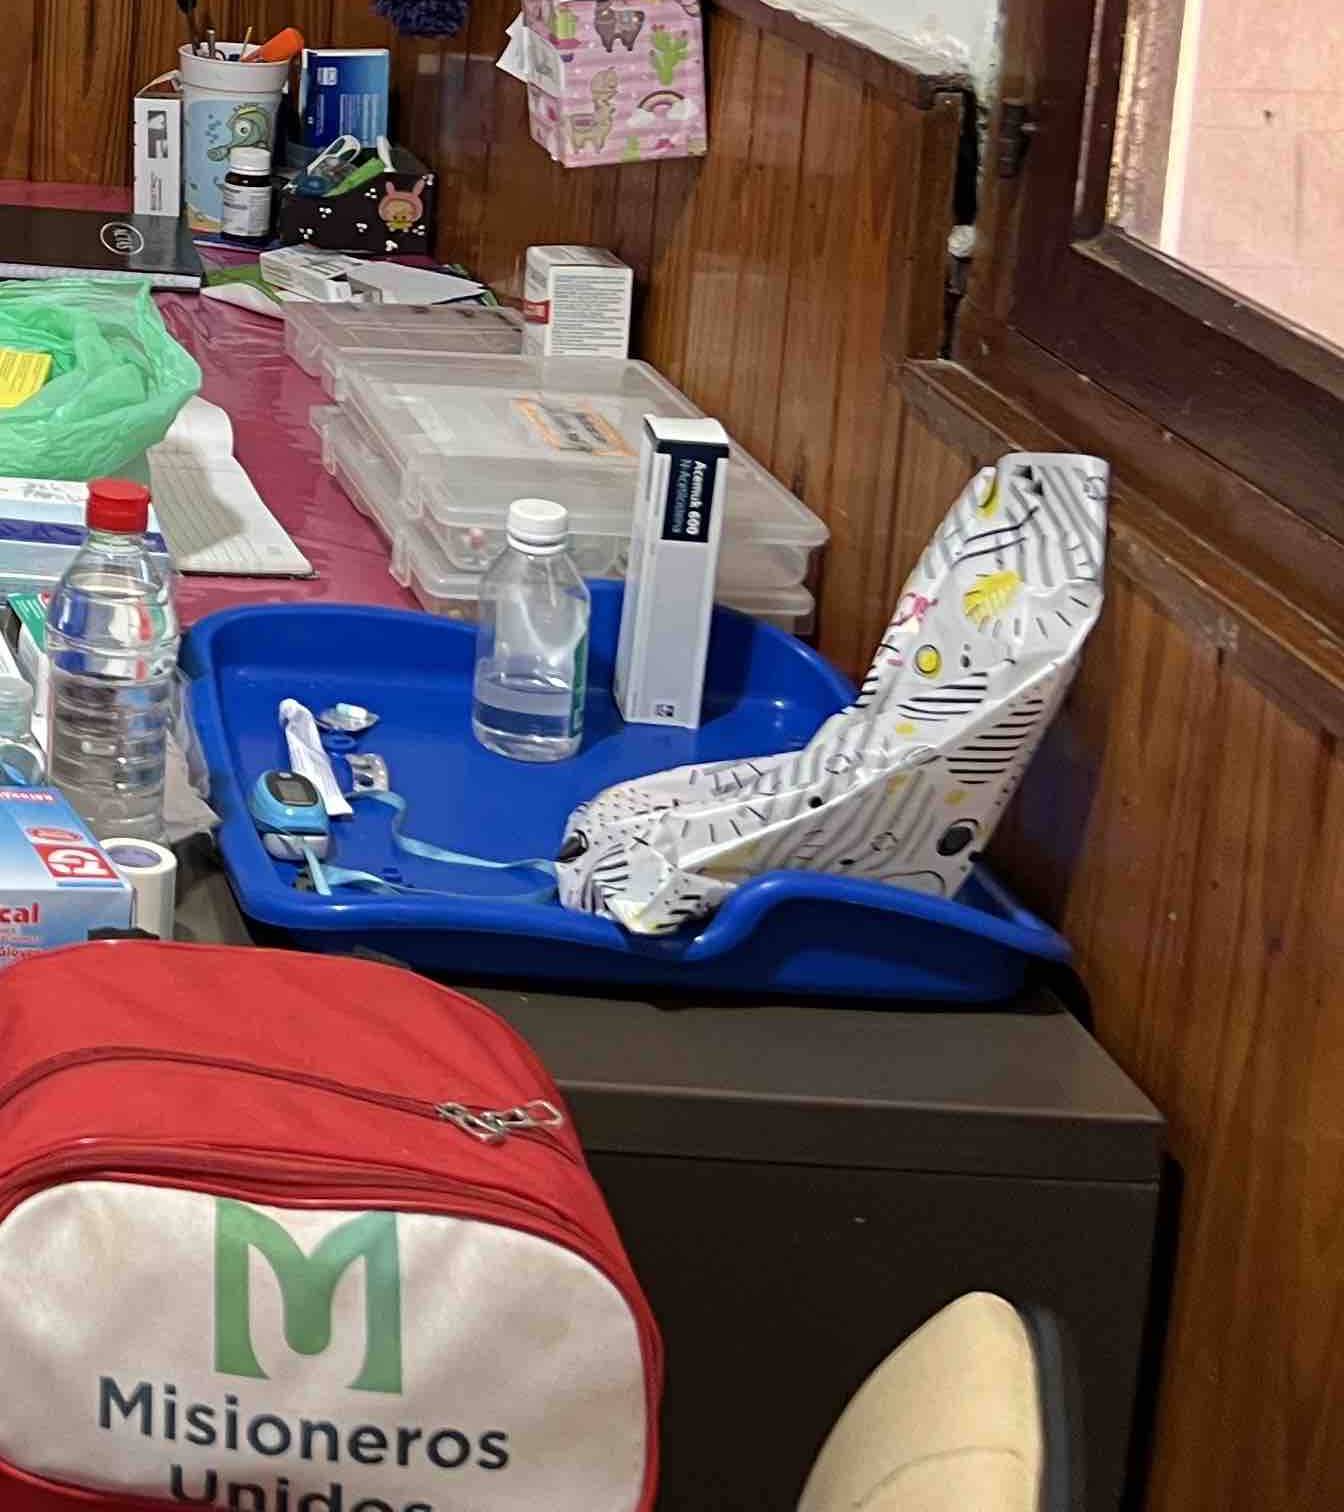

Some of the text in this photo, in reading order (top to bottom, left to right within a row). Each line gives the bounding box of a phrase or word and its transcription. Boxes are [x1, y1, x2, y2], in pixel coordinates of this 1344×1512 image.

[686, 511, 702, 535] 600
[98, 1375, 510, 1470] Misioneros
[169, 1463, 434, 1512] Unid
